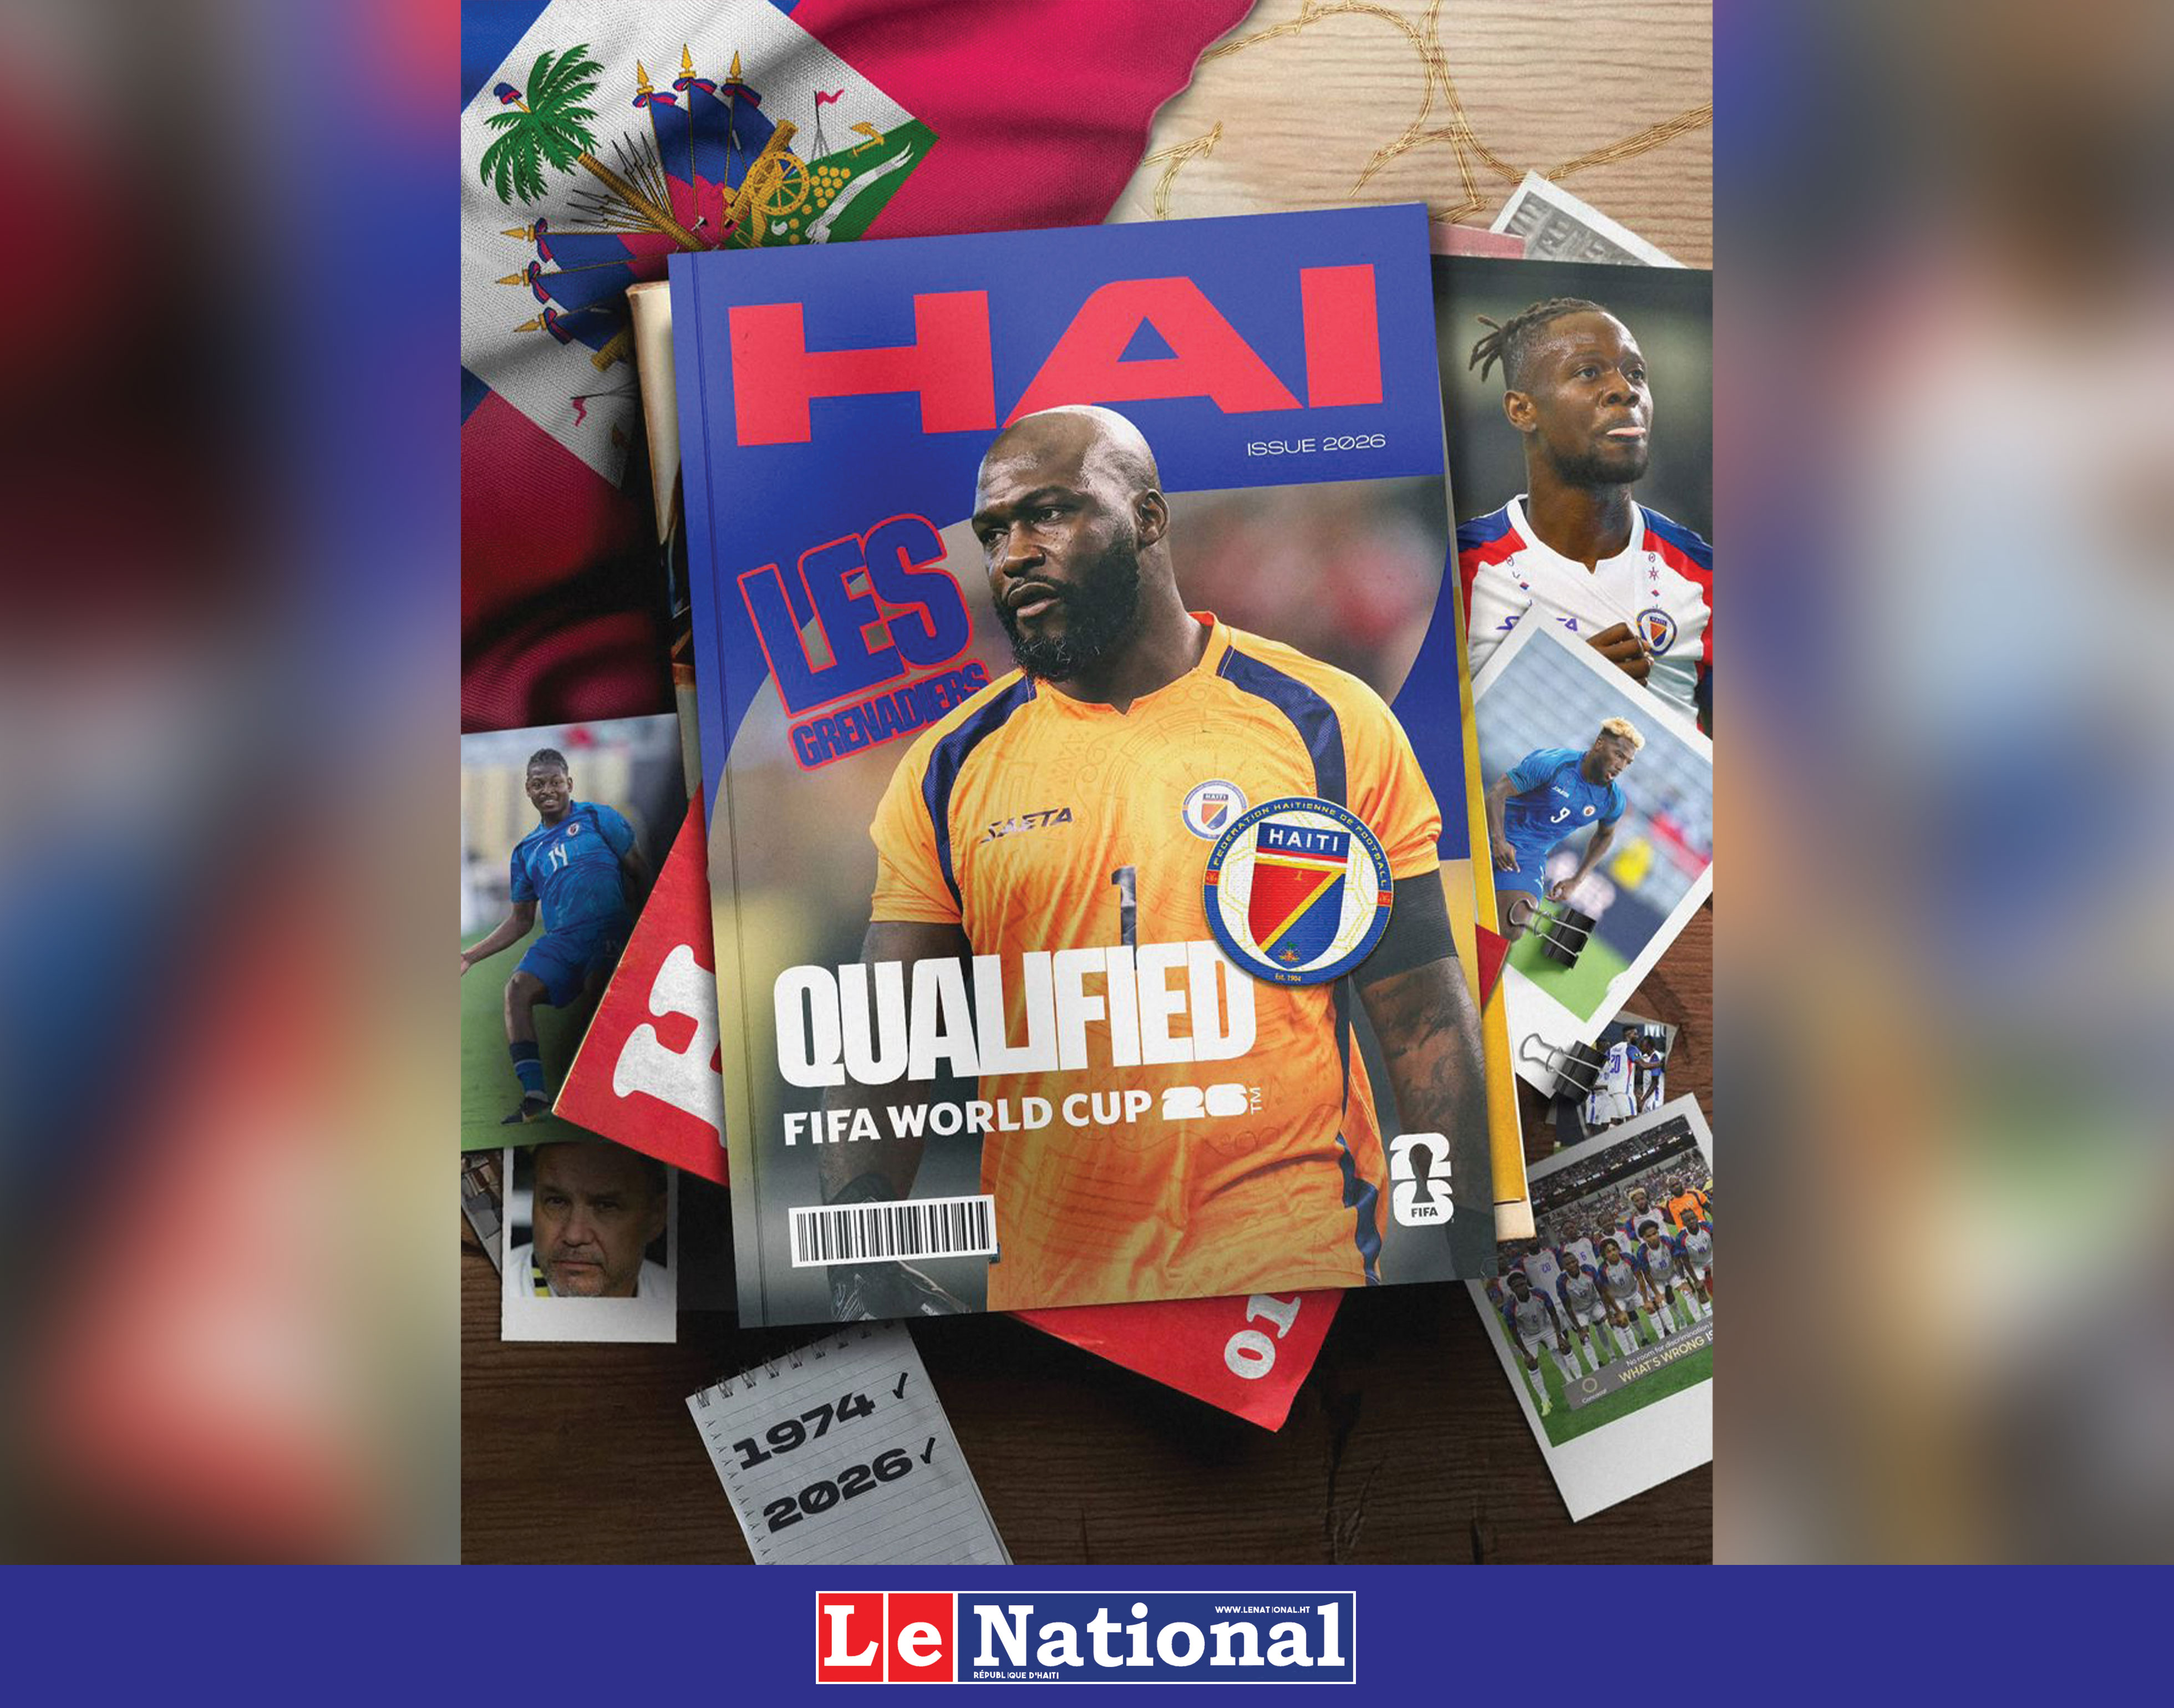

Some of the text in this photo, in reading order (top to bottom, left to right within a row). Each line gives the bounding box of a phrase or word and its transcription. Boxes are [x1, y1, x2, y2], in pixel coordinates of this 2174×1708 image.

[729, 264, 1383, 446] HAI
[1248, 434, 1386, 456] ISSUE 2026
[737, 514, 972, 718] LES
[788, 658, 992, 771] GRENADIERS
[1269, 828, 1338, 851] HAITI
[1551, 806, 1571, 823] 9
[774, 939, 1256, 1087] QUALIFIED
[783, 1107, 880, 1146] FIFA
[886, 1096, 1053, 1138] WORLD
[1073, 1090, 1152, 1127] CUP
[1162, 1083, 1248, 1120] 26
[1411, 1207, 1438, 1217] FIFA
[1617, 1356, 1661, 1382] WHAT'S
[1660, 1336, 1705, 1362] WRONG
[1637, 1350, 1655, 1360] room
[733, 1392, 876, 1470] 1974
[763, 1448, 913, 1533] 2026
